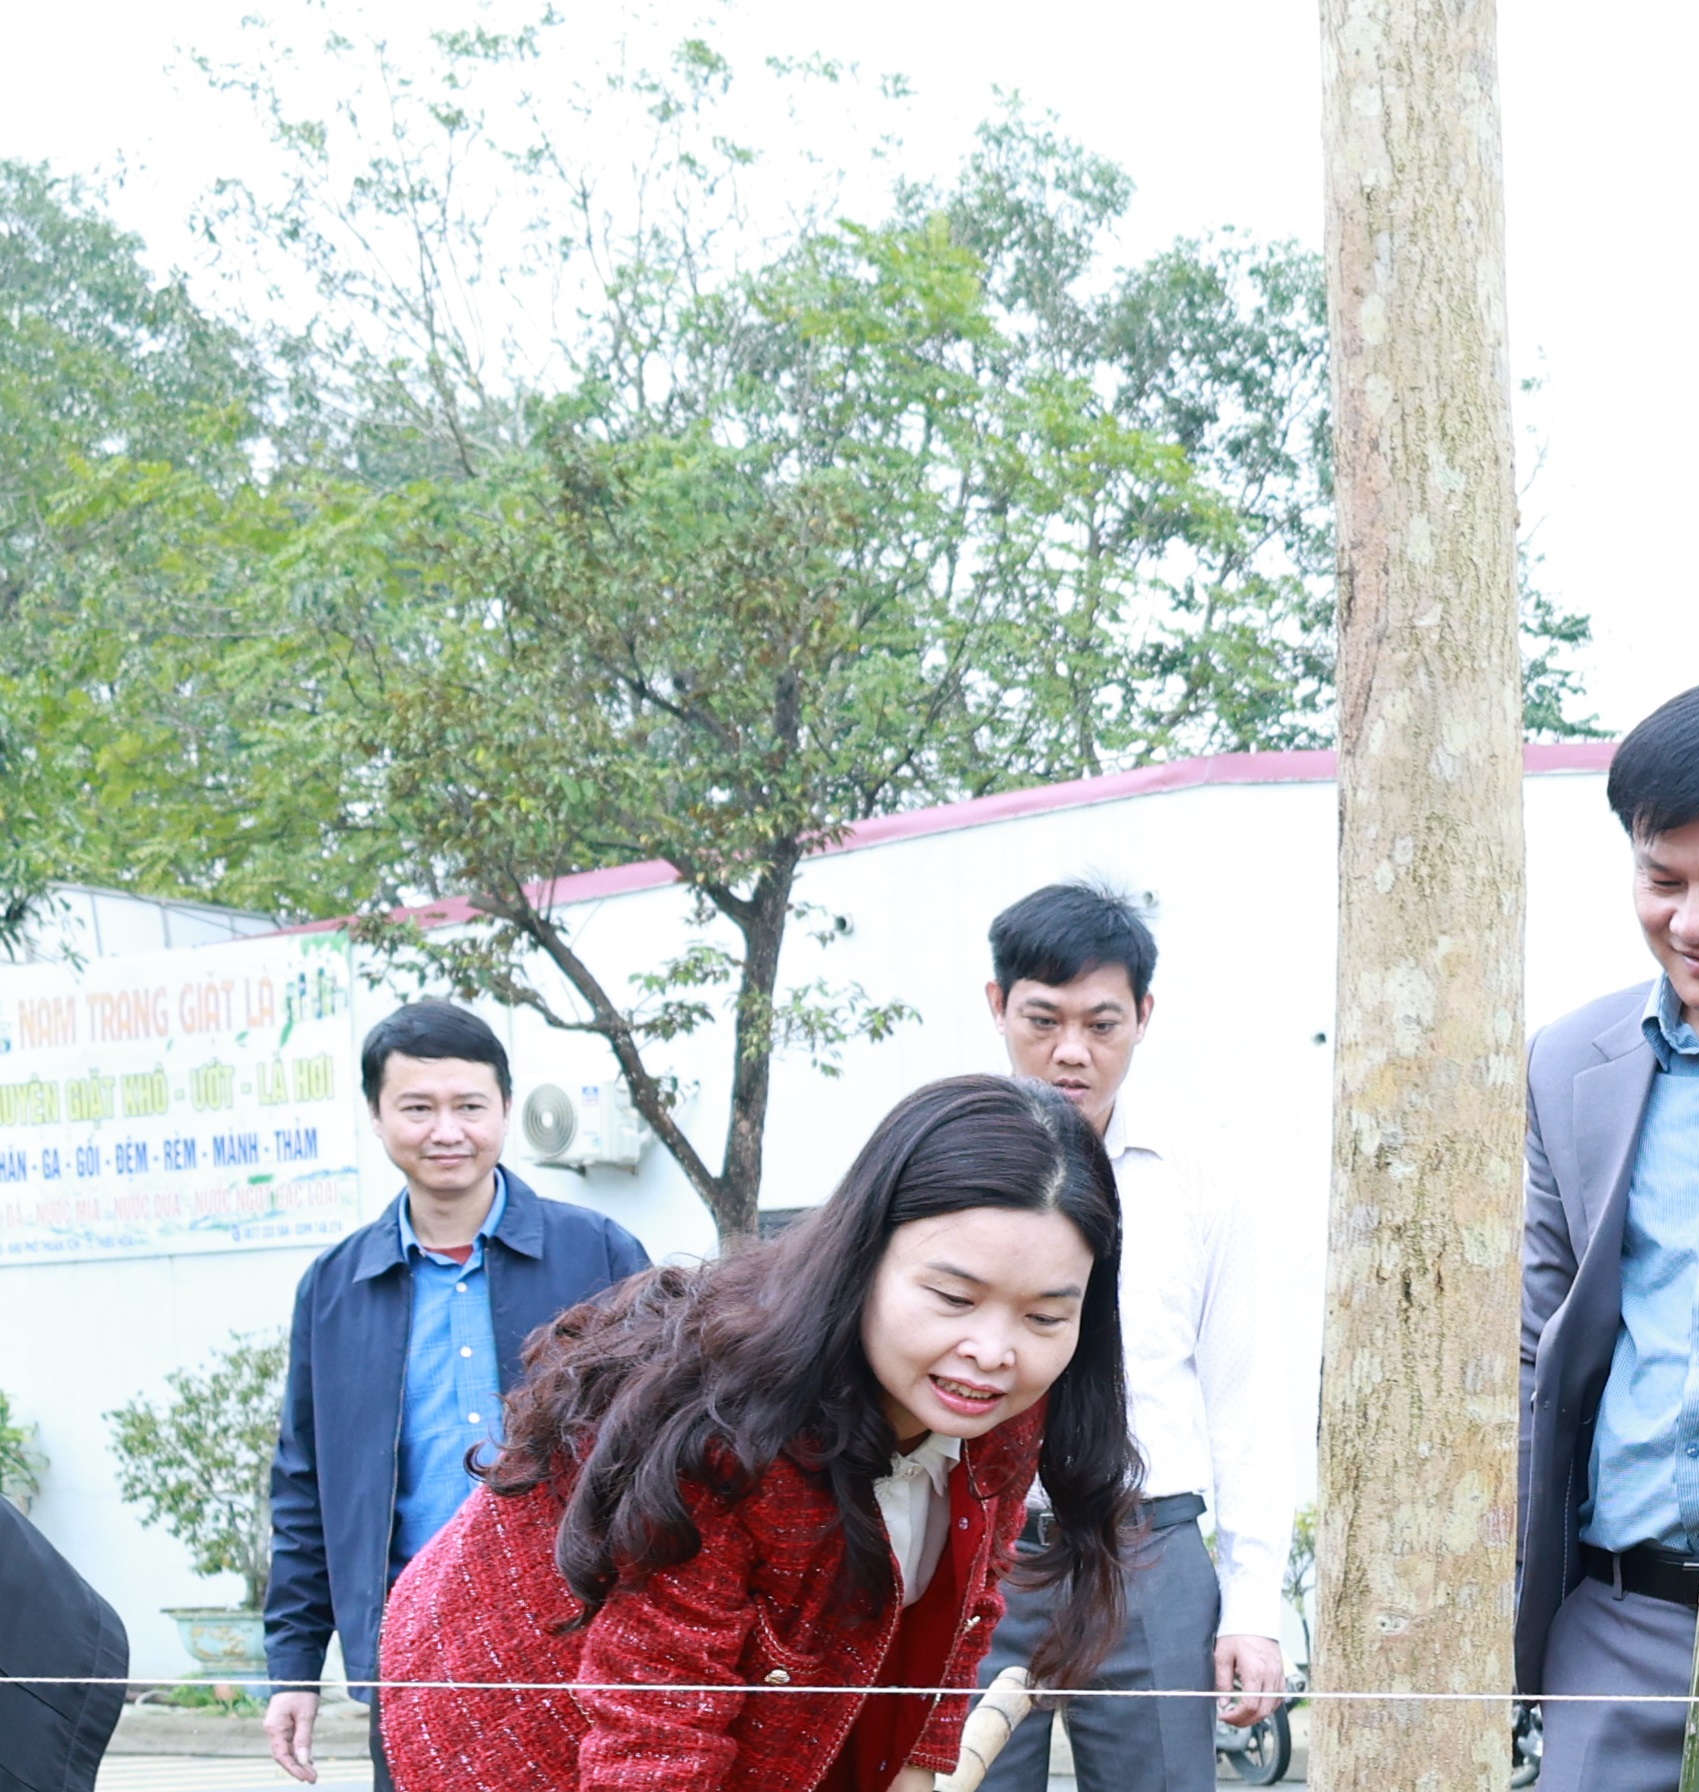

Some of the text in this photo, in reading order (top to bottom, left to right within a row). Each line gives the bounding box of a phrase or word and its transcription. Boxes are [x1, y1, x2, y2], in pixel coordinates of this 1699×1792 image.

[18, 995, 76, 1049] NAM
[86, 986, 169, 1044] TRANG
[66, 1067, 115, 1130] GIẶT
[121, 1062, 169, 1117] KHÔ
[257, 1050, 289, 1106] LÀ
[293, 1051, 335, 1103] HƠI
[42, 1147, 61, 1180] GA
[76, 1133, 100, 1178] GỐI
